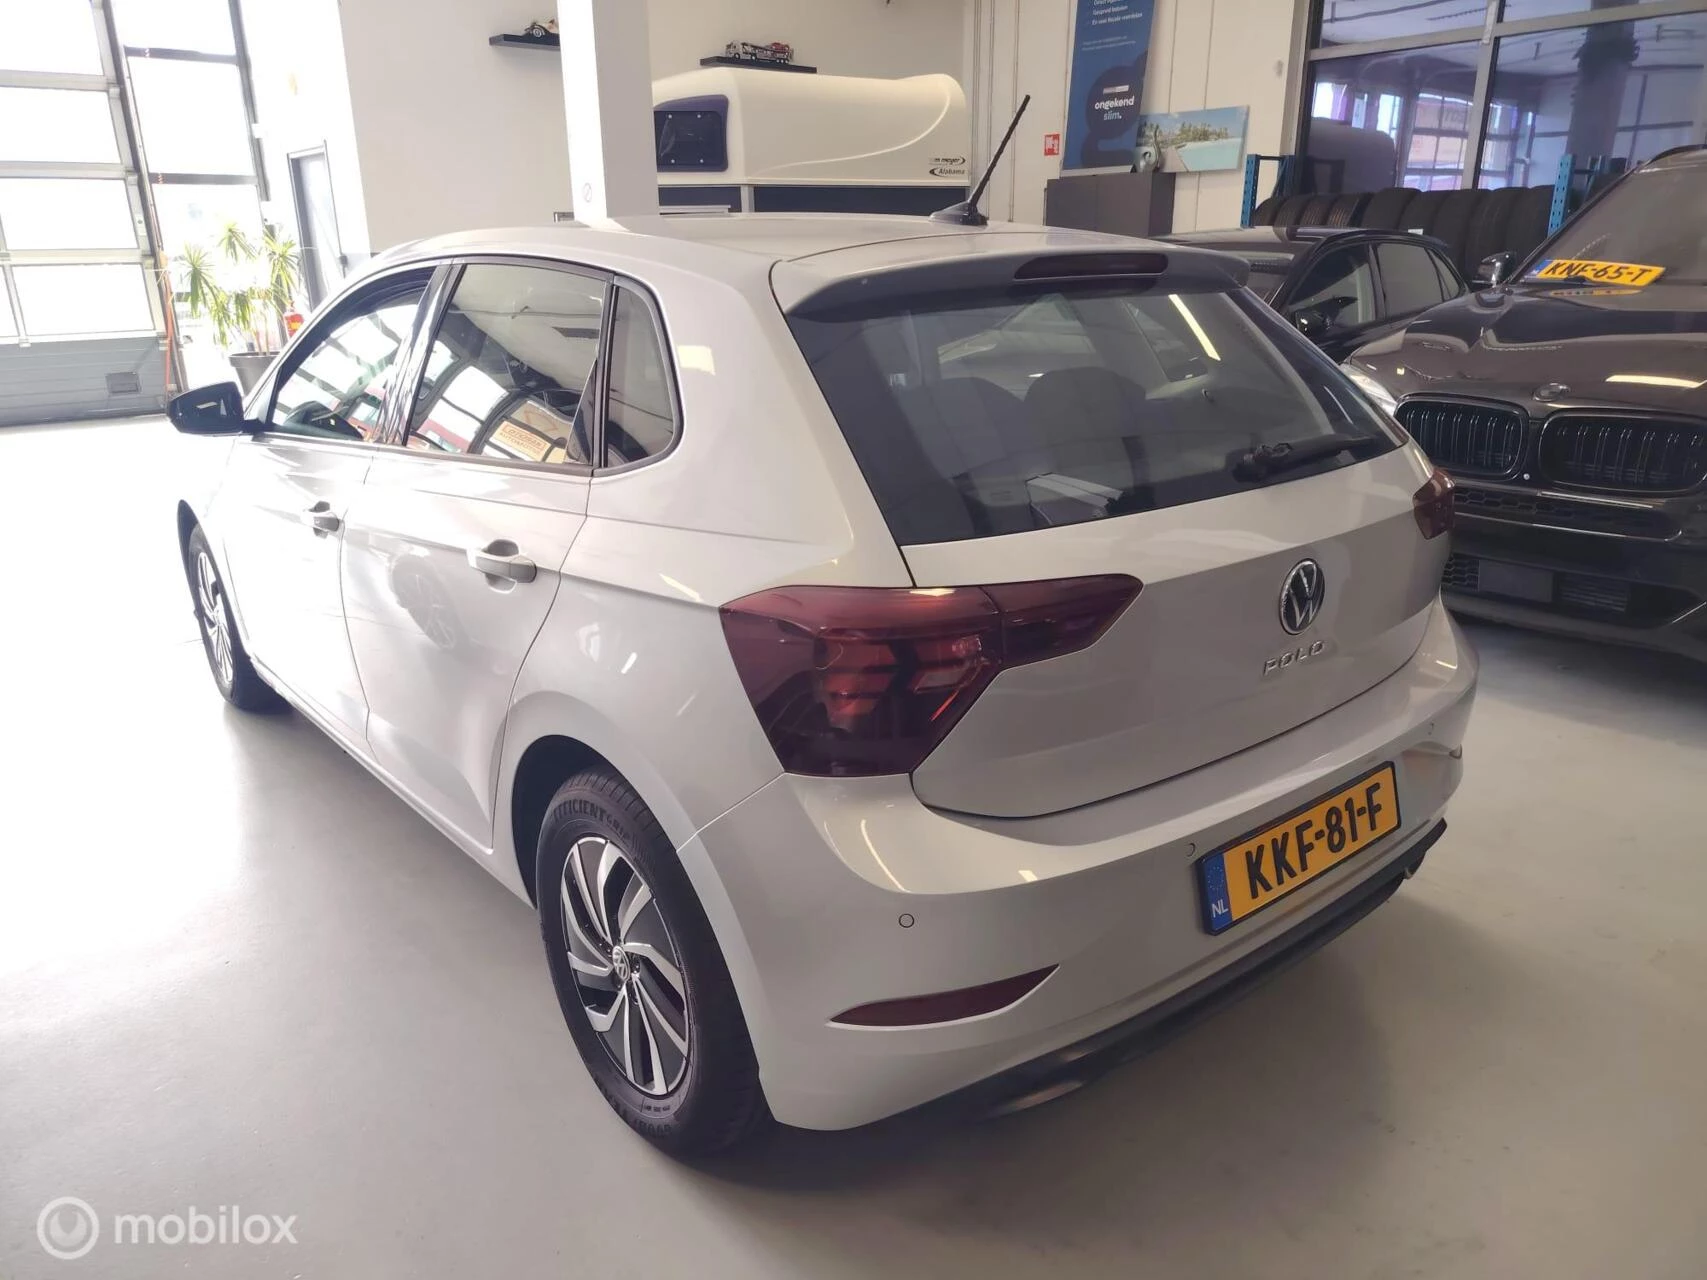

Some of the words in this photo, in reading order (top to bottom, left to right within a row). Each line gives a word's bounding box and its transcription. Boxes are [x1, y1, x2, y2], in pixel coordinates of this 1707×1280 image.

[1094, 94, 1135, 110] ongekend
[1544, 261, 1653, 283] KNF-65-T
[1263, 640, 1325, 677] POLO
[1244, 782, 1383, 900] KKF-81-F
[1210, 898, 1229, 919] NL
